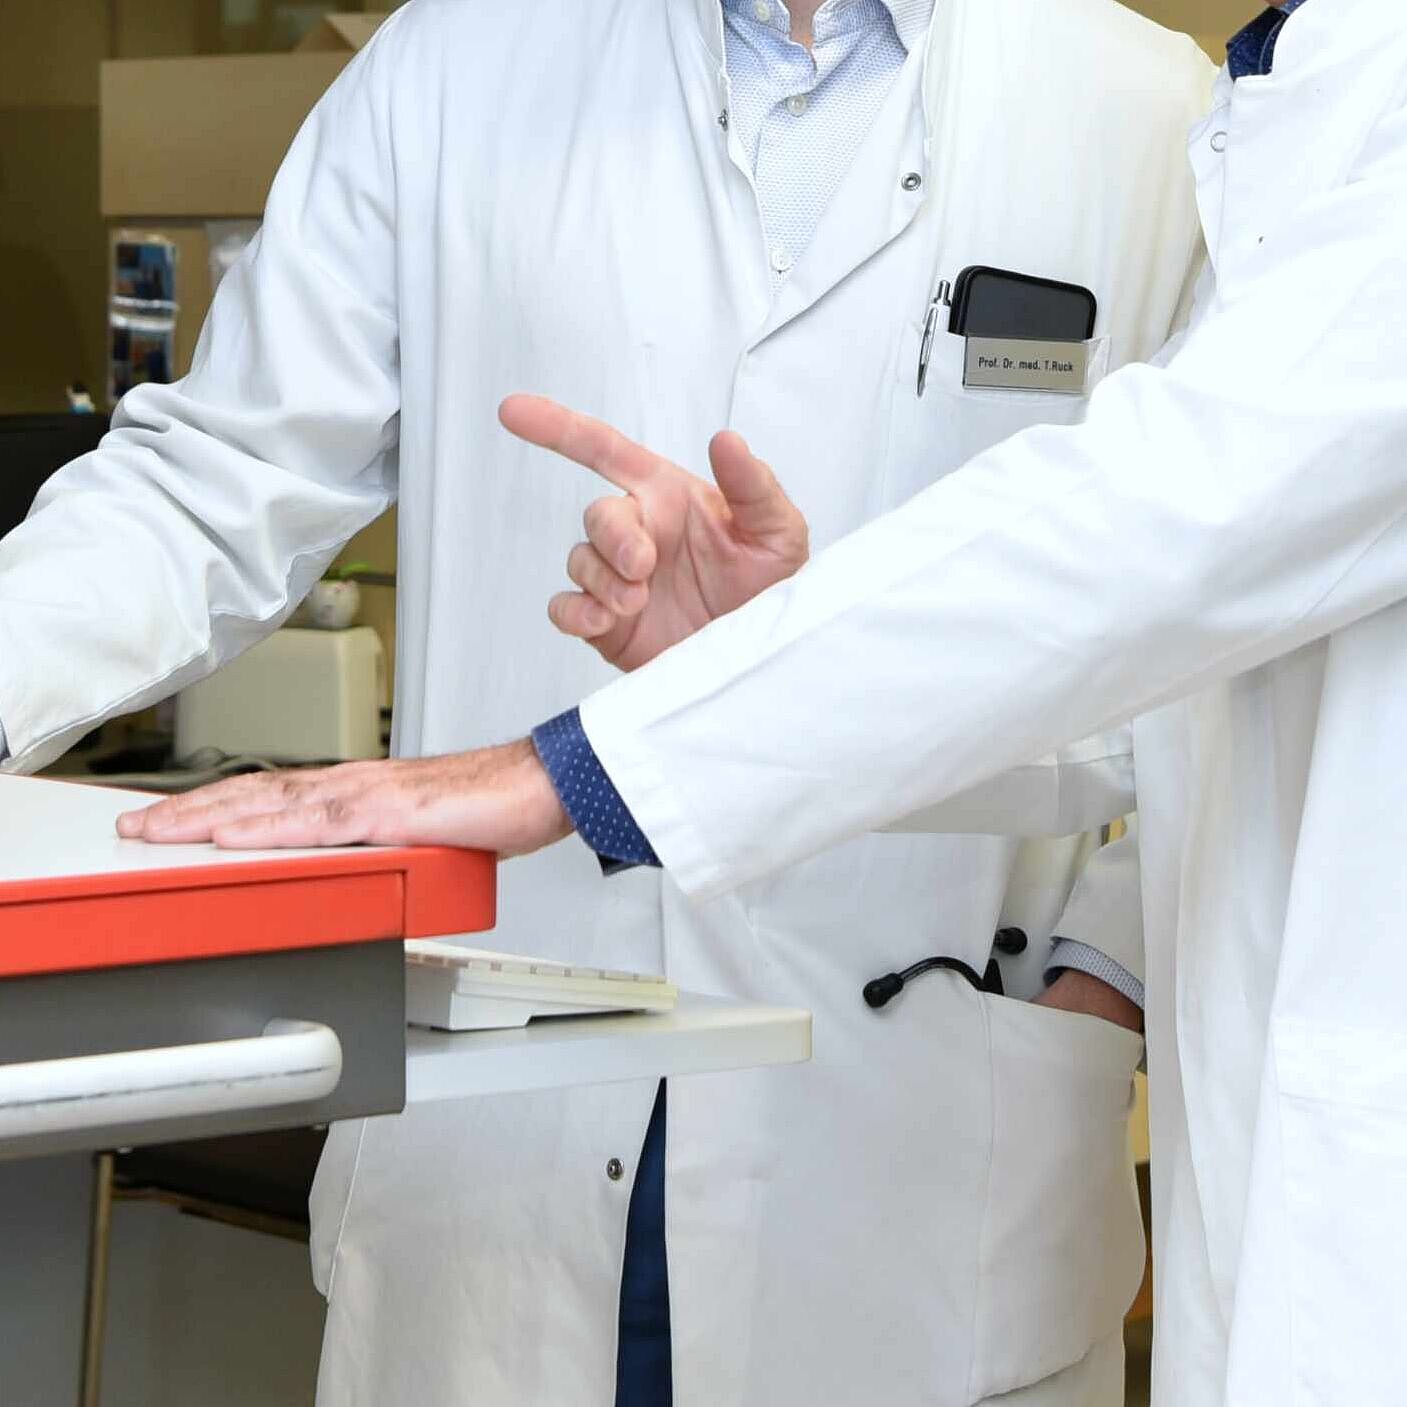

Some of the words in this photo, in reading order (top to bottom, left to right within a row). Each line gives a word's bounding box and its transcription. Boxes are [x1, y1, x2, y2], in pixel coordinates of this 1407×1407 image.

[978, 356, 1001, 369] Prof.
[1003, 357, 1016, 370] Dr.
[1019, 360, 1041, 370] med.
